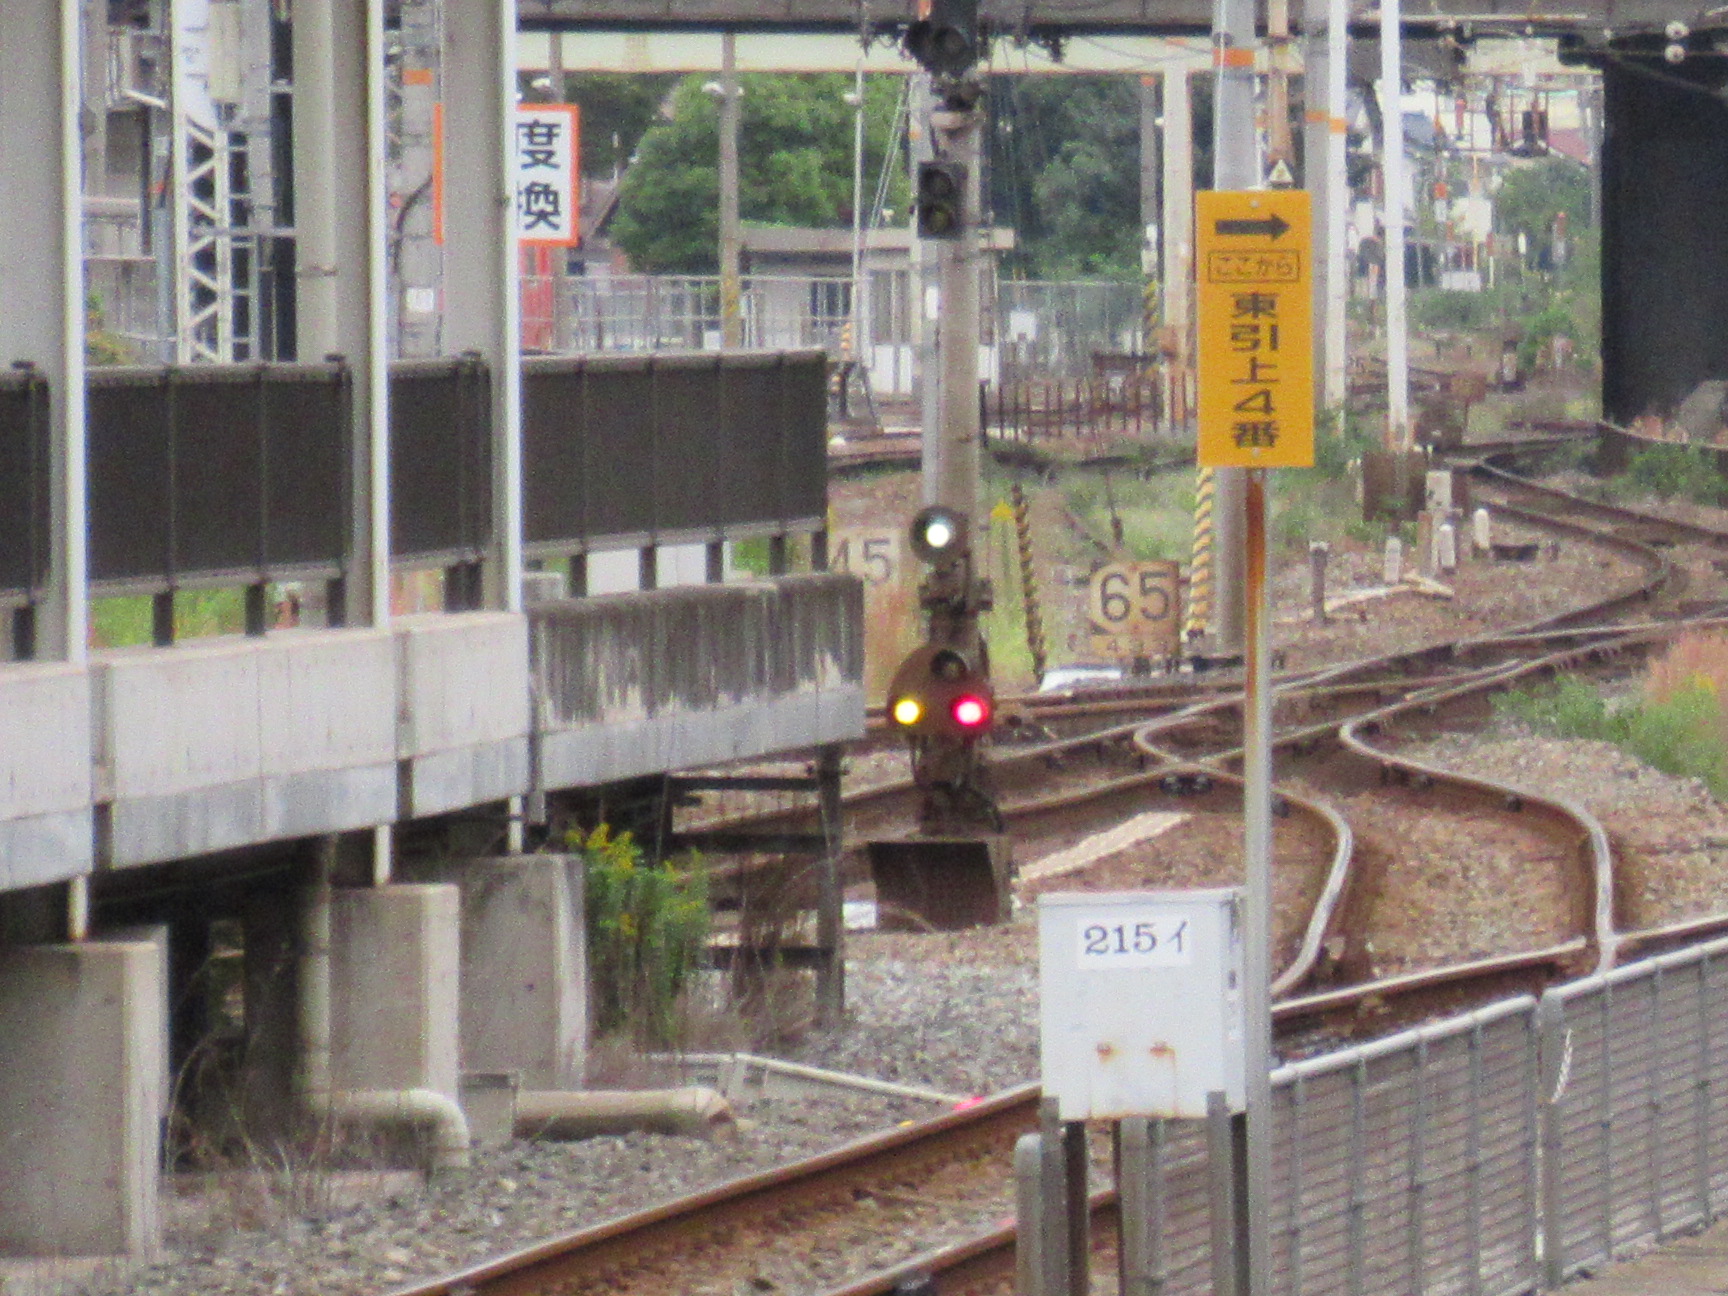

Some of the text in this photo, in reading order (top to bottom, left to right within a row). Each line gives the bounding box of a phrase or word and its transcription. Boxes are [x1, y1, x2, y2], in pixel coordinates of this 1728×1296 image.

[1215, 255, 1293, 277] ここから
[1101, 572, 1169, 621] 65
